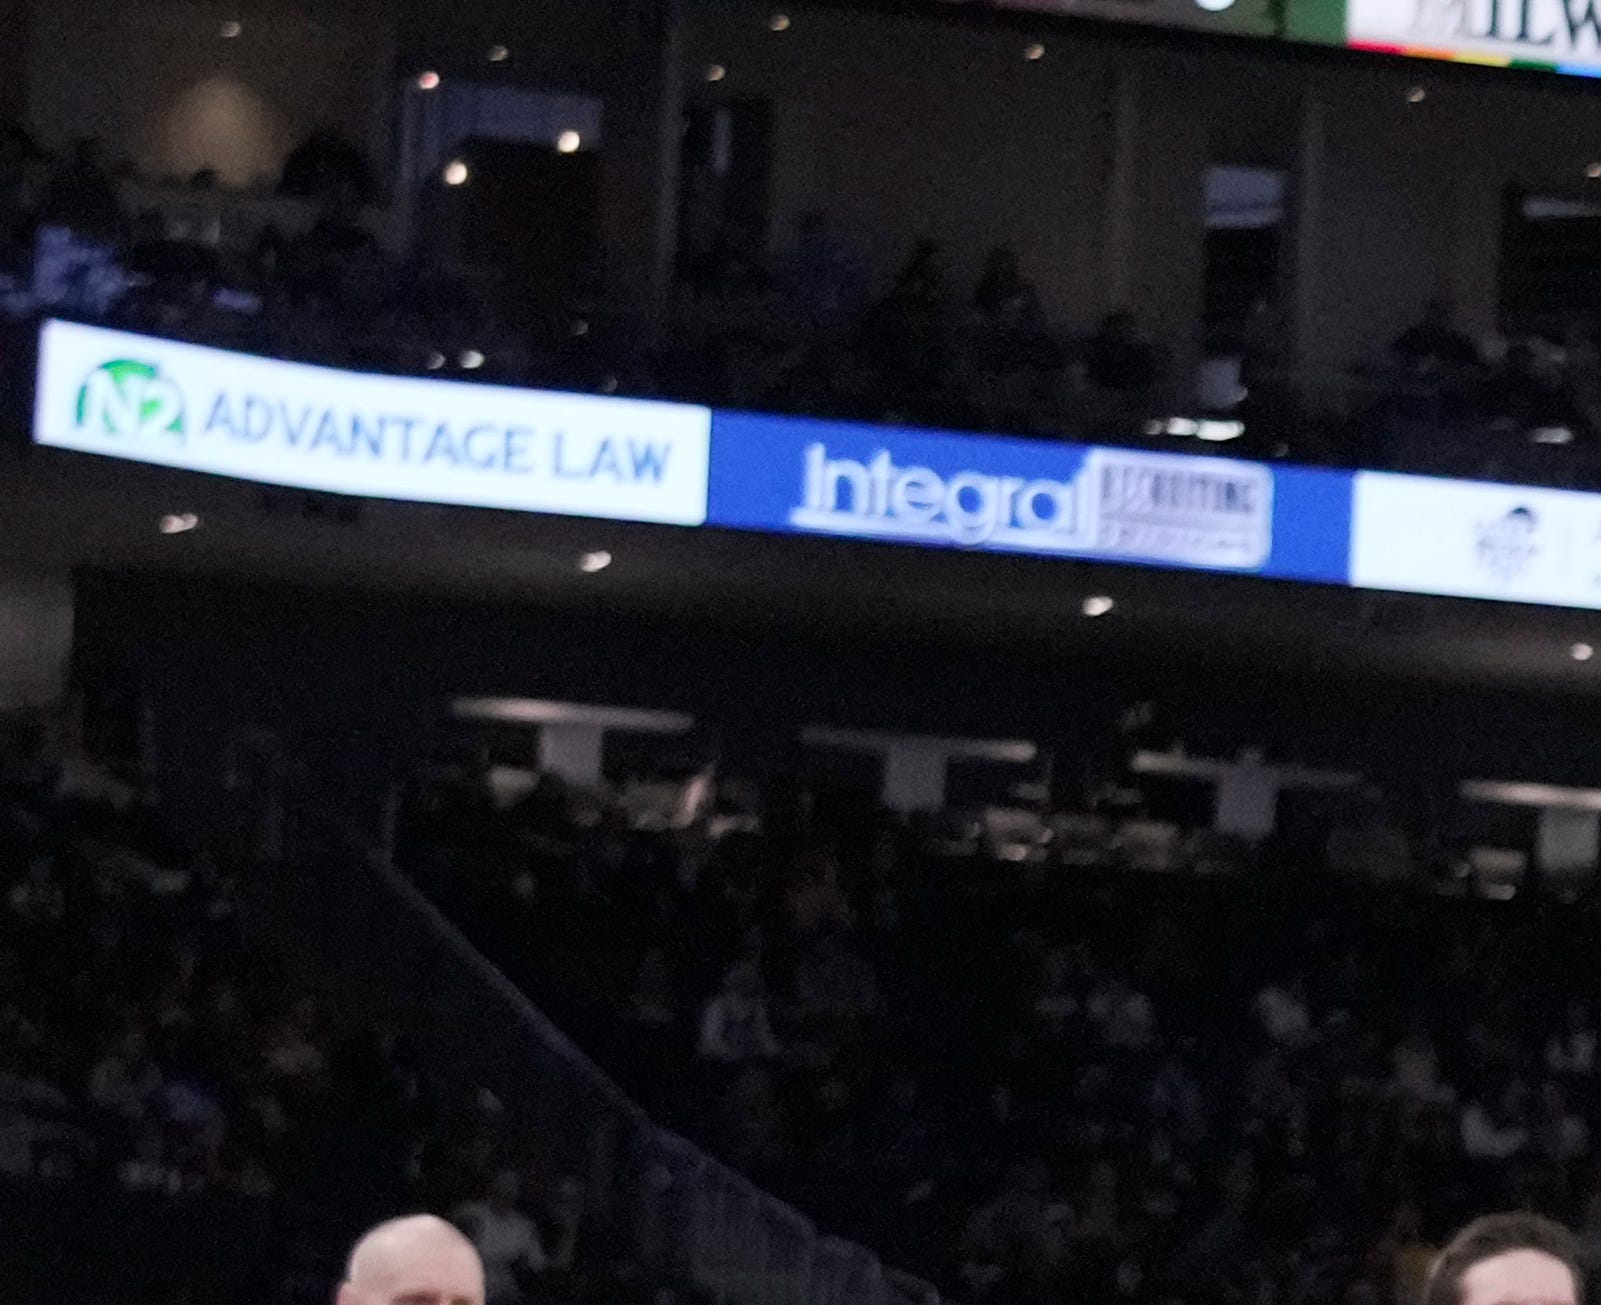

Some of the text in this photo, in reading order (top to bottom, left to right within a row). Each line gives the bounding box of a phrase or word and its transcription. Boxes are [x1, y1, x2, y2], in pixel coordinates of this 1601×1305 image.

[204, 391, 673, 484] ADVANTAGE LAW
[804, 442, 1090, 547] Integral
